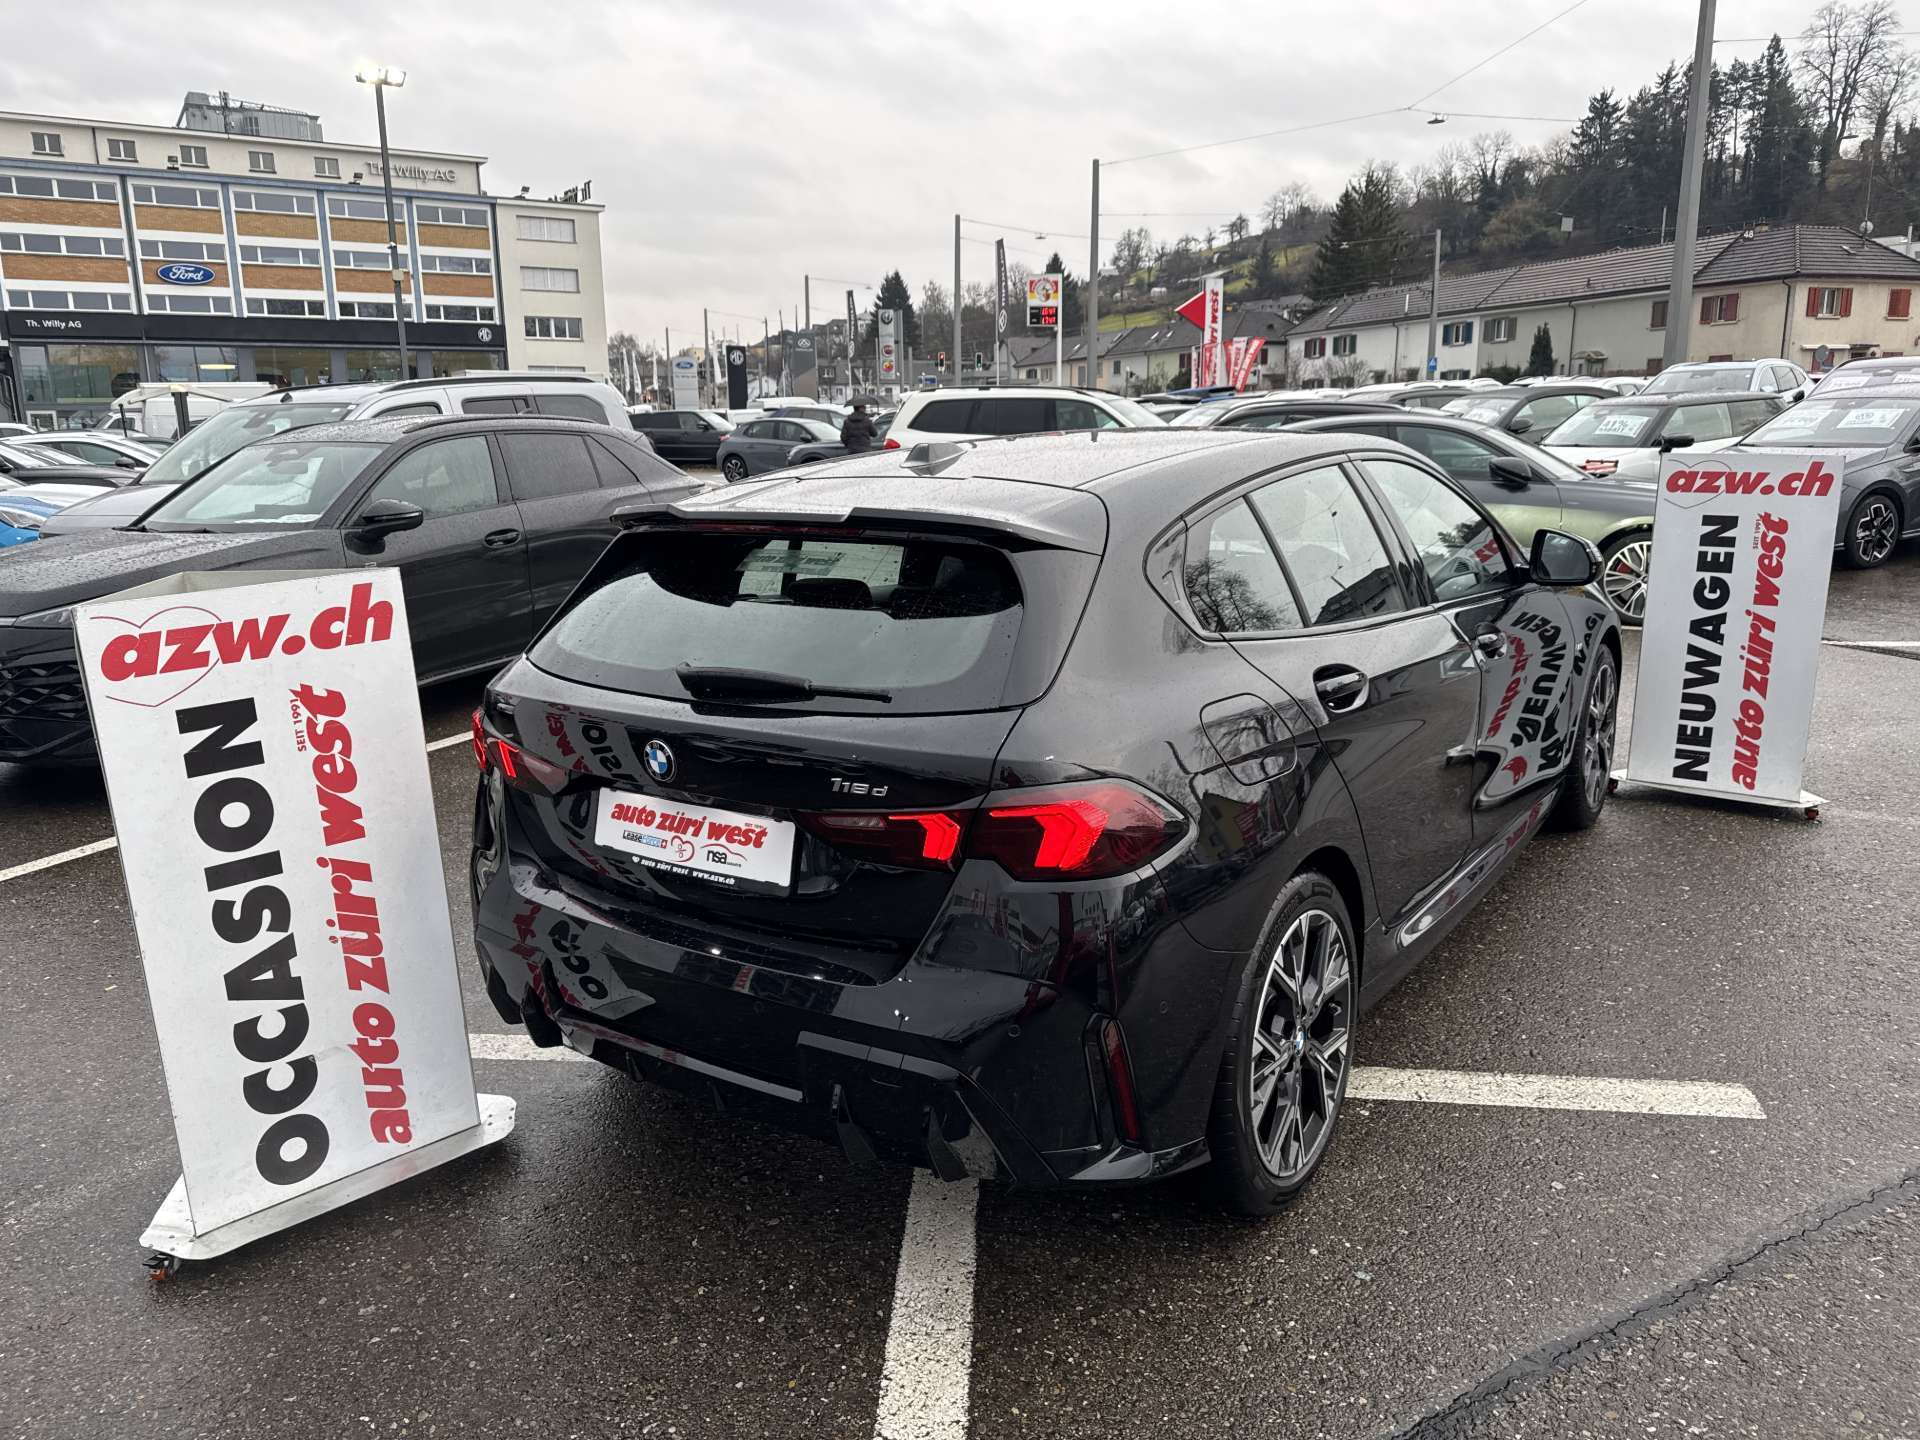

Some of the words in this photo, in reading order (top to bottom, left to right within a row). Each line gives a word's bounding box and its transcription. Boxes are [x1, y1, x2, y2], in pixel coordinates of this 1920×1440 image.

[434, 167, 457, 183] AG
[169, 265, 204, 281] Ford
[25, 319, 40, 328] Th.
[42, 319, 66, 330] Willy
[67, 320, 82, 329] AG
[729, 350, 744, 365] MG
[1666, 461, 1835, 497] azw.ch
[1753, 511, 1788, 606] west
[102, 583, 394, 682] azw.ch
[1672, 514, 1739, 782] NEUWAGEN
[1742, 609, 1776, 700] züri
[290, 698, 302, 725] 1991
[295, 729, 307, 751] SEIT
[1731, 699, 1764, 791] auto
[289, 683, 366, 846] west
[611, 803, 657, 827] auto
[656, 811, 707, 837] züri
[707, 821, 768, 849] west
[640, 859, 656, 868] auto
[672, 867, 690, 876] west
[706, 849, 728, 865] nsa
[176, 697, 330, 1186] OCCASION
[316, 856, 389, 993] züri
[363, 1002, 412, 1144] auto
